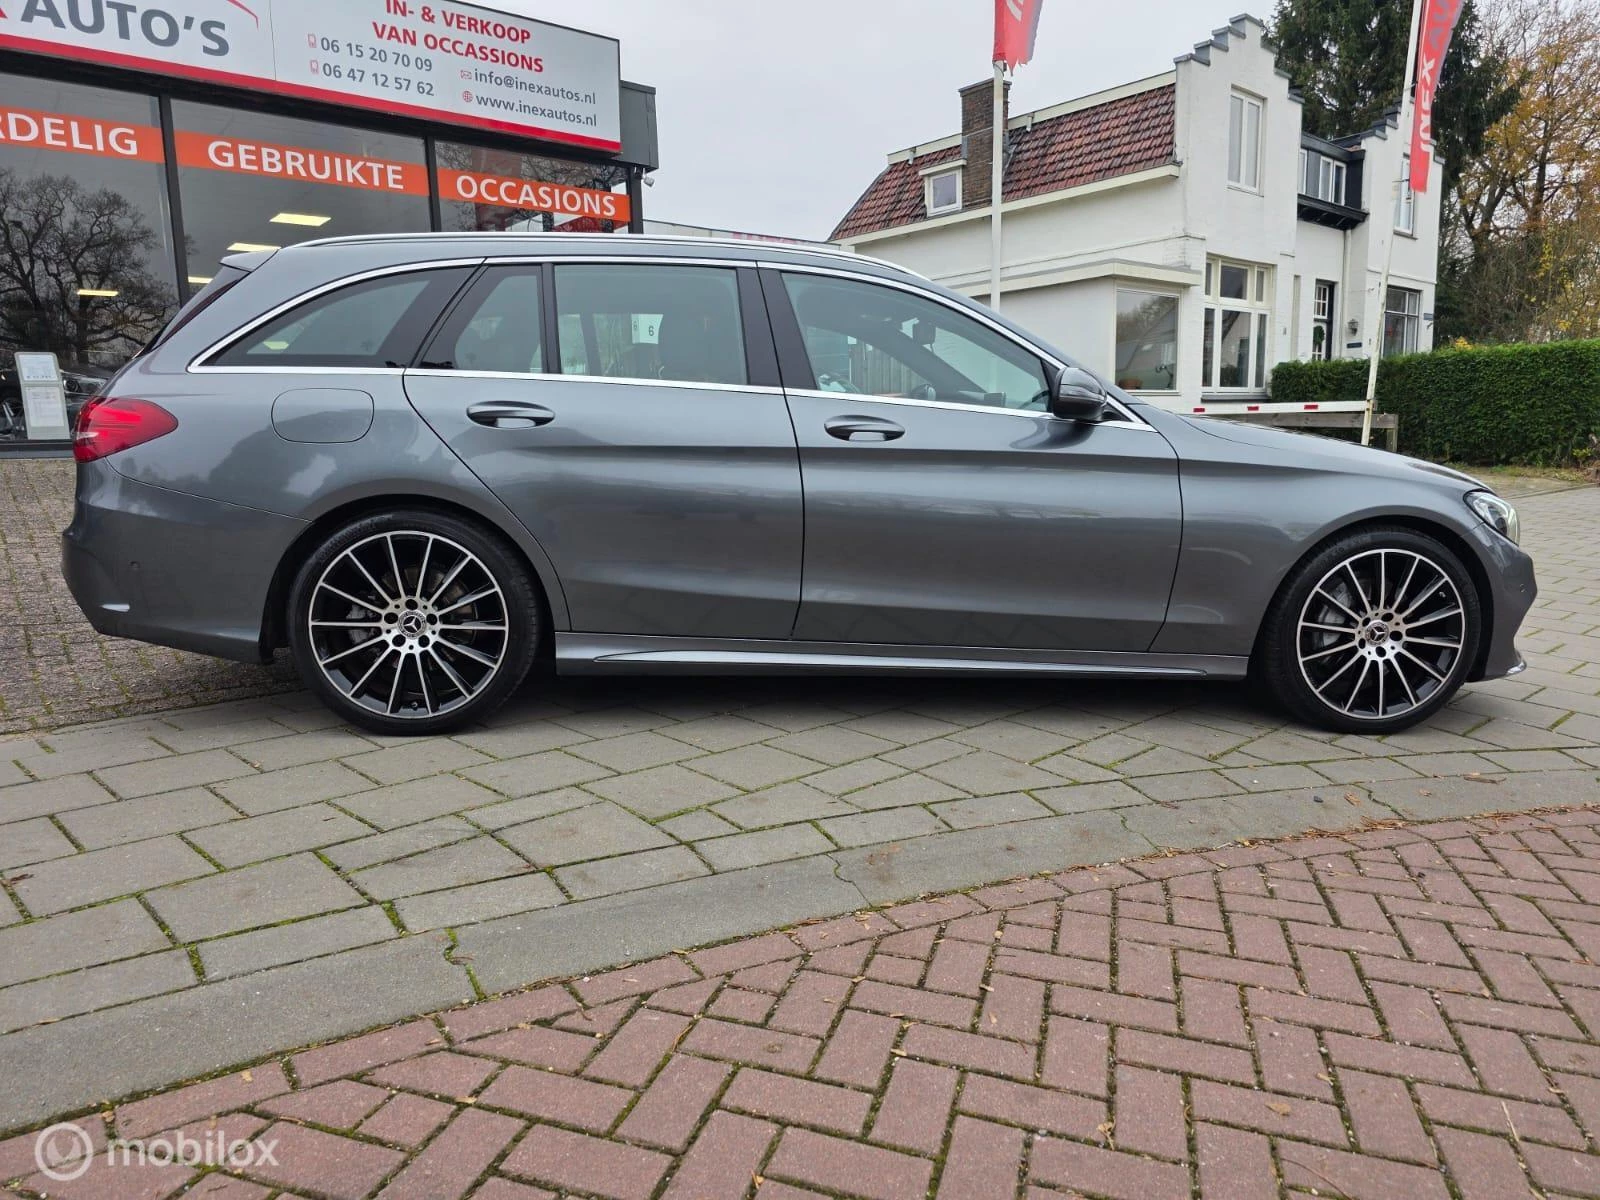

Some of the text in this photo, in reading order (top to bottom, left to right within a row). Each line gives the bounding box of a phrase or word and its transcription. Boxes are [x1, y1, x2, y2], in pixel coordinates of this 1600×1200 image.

[21, 0, 230, 57] AUTO'S
[385, 0, 531, 44] IN- & VERKOOP
[320, 37, 433, 72] 06 15 20 70 09
[372, 21, 544, 73] VAN OCCASSIONS
[322, 63, 435, 96] 06 47 12 57 62
[474, 68, 597, 105] info@inexautos.nl
[475, 94, 598, 127] www.inexautos.nl
[0, 112, 616, 217] DELIG GEBRUIKTE OCCASIONS
